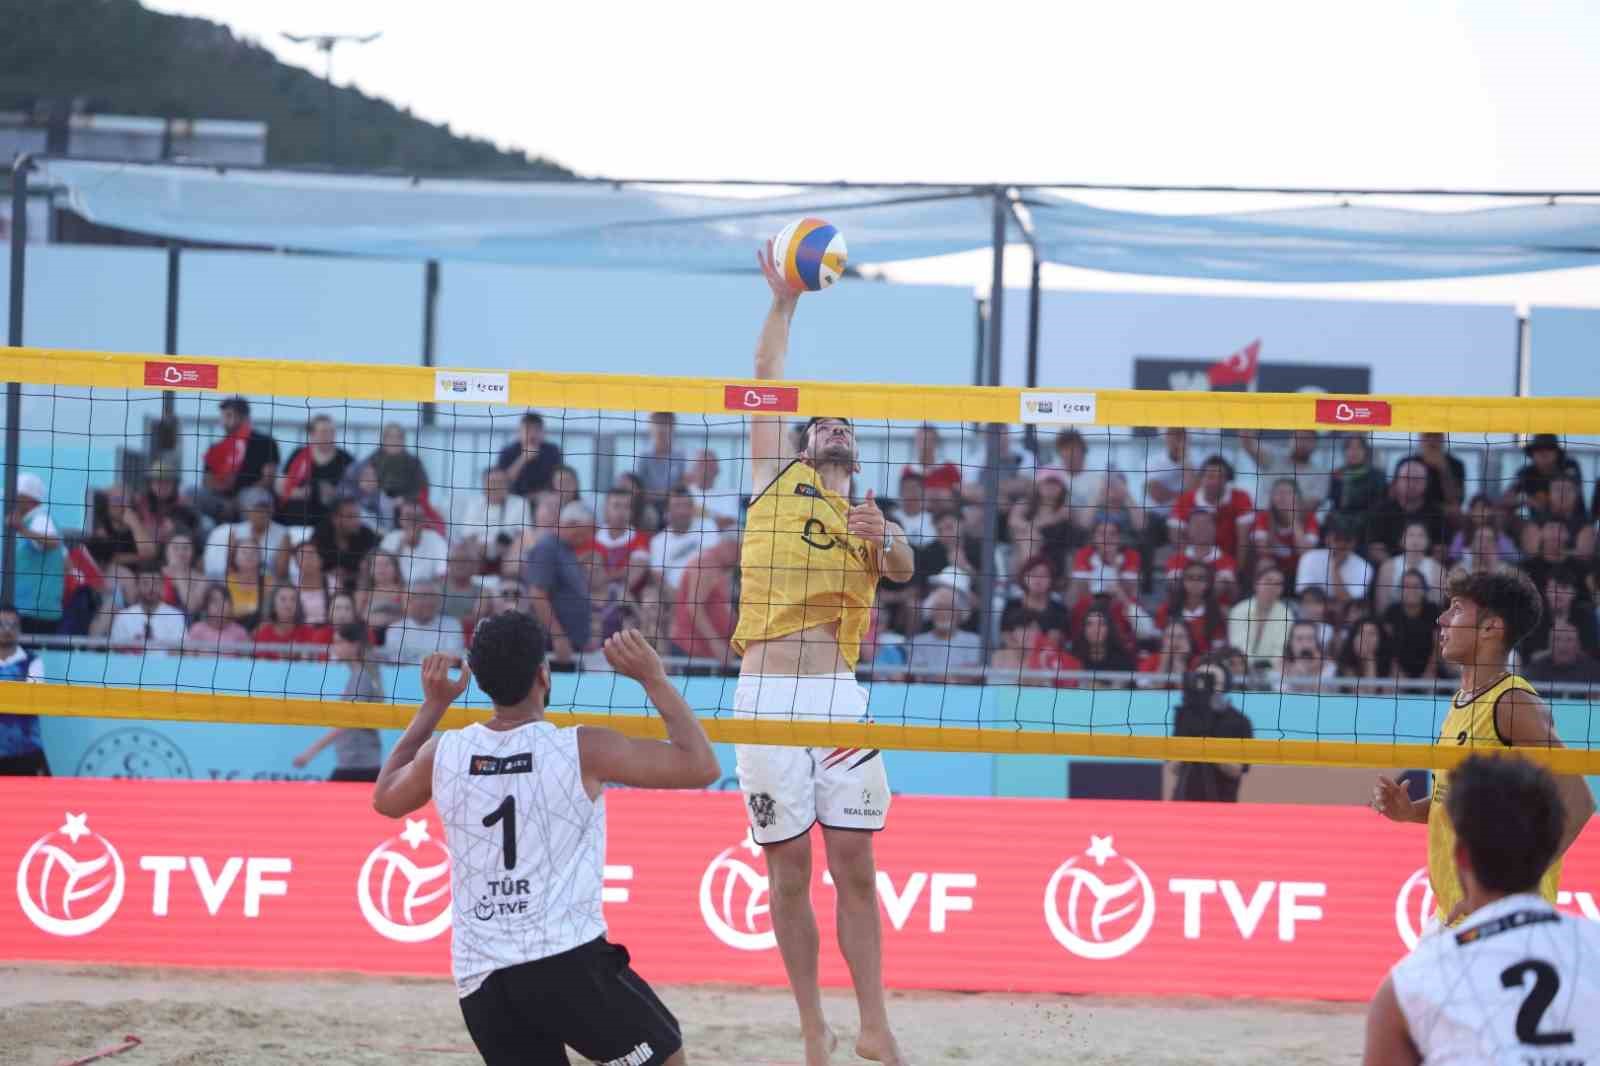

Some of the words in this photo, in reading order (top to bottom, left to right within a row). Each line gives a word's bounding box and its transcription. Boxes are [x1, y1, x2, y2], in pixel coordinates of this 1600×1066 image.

[488, 383, 504, 392] CEV
[1073, 404, 1091, 412] CEV
[482, 794, 517, 871] 1
[139, 855, 293, 918] TVF
[488, 877, 530, 897] TÜR
[499, 901, 529, 915] TVF
[822, 871, 978, 933] VF
[1168, 878, 1327, 942] TVF
[1500, 959, 1575, 1046] 2
